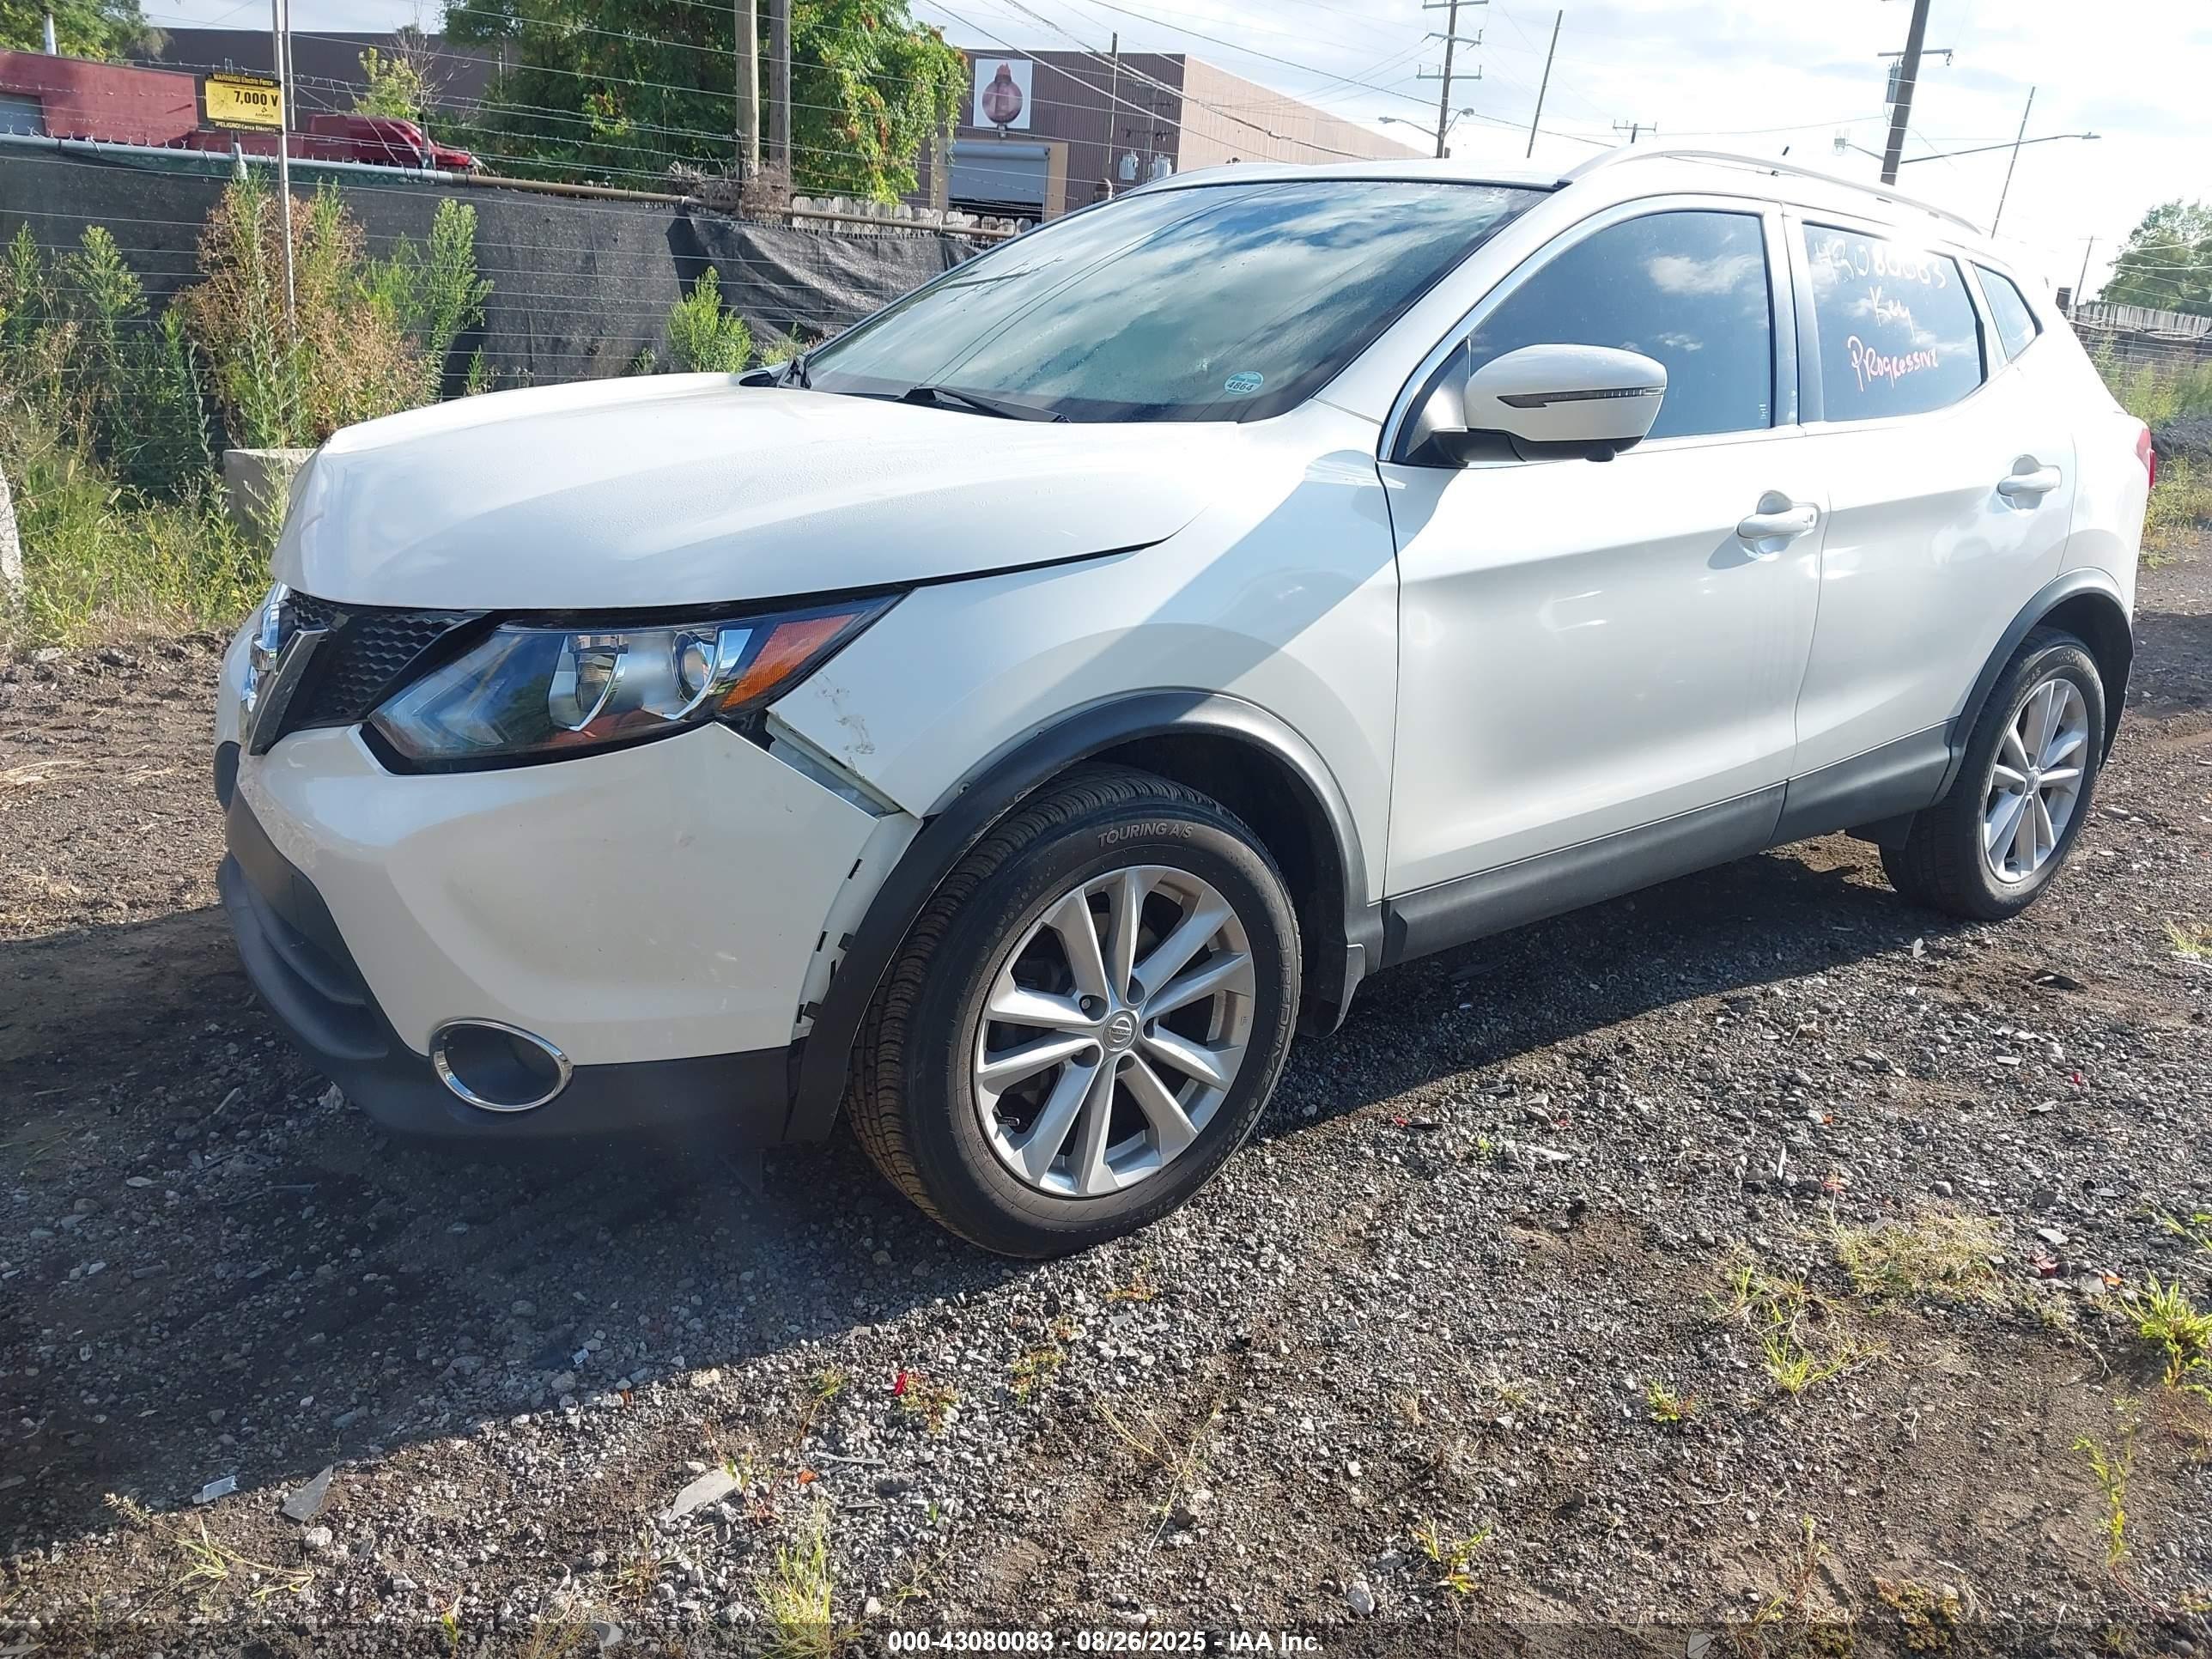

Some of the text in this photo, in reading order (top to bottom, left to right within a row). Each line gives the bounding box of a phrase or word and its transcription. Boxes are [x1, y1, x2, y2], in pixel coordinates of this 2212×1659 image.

[234, 91, 278, 106] 7,000 V
[1227, 381, 1255, 391] 4864
[1097, 823, 1194, 848] TOURING A/S
